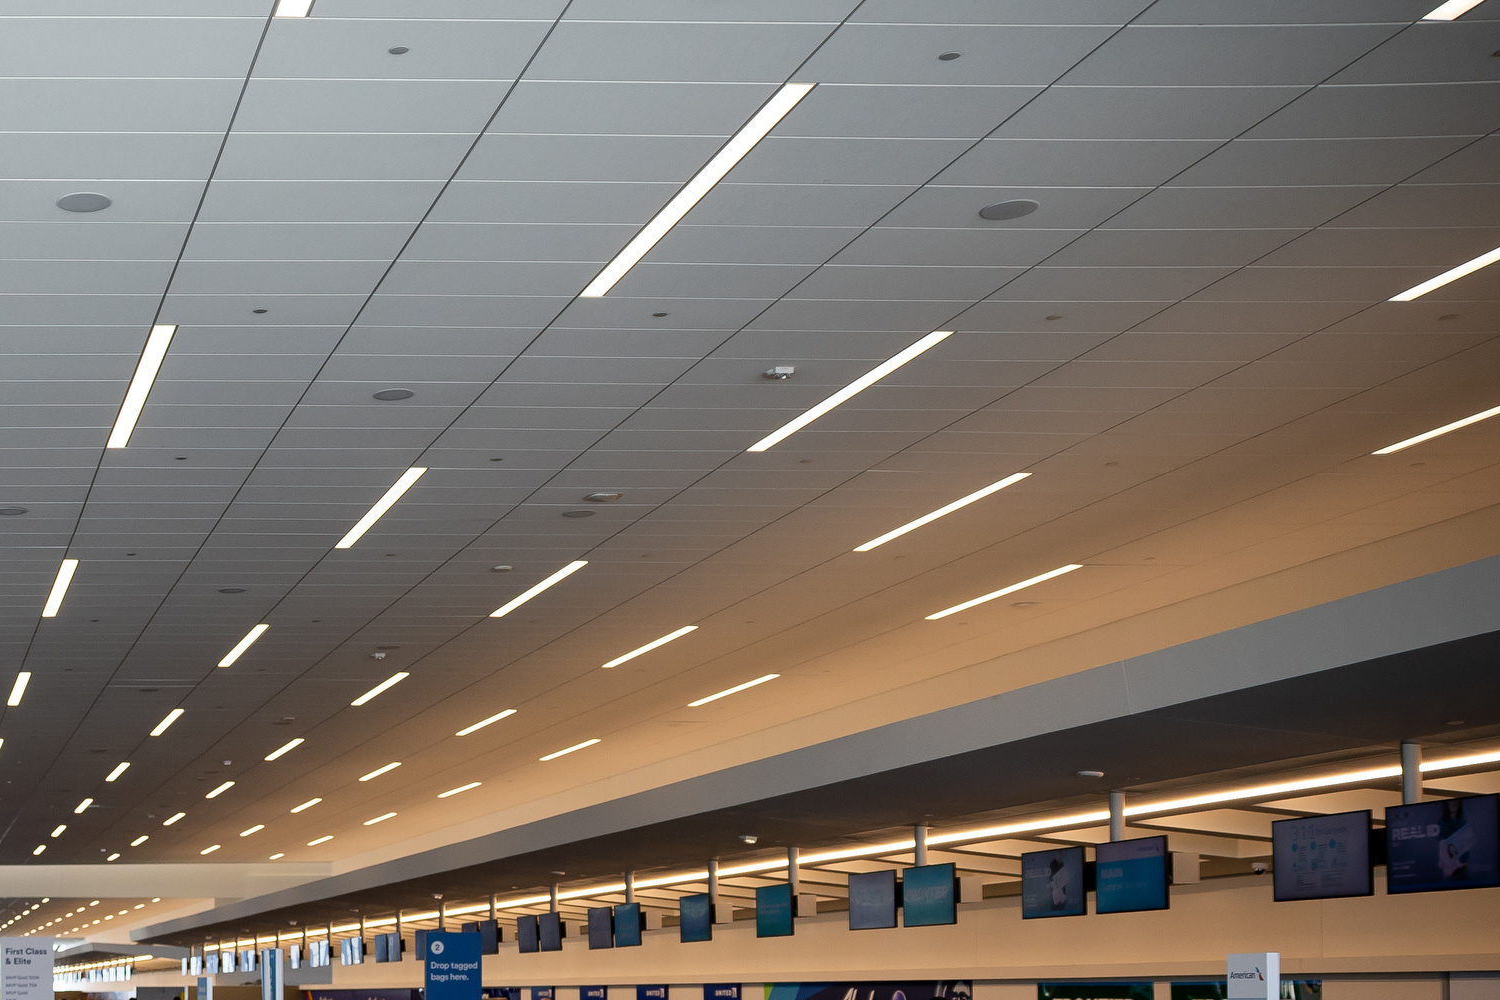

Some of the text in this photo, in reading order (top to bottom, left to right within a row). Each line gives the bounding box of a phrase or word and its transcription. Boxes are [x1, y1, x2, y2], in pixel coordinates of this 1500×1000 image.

[430, 962, 478, 971] Drop tagged
[430, 973, 449, 982] bags
[1230, 971, 1256, 979] American
